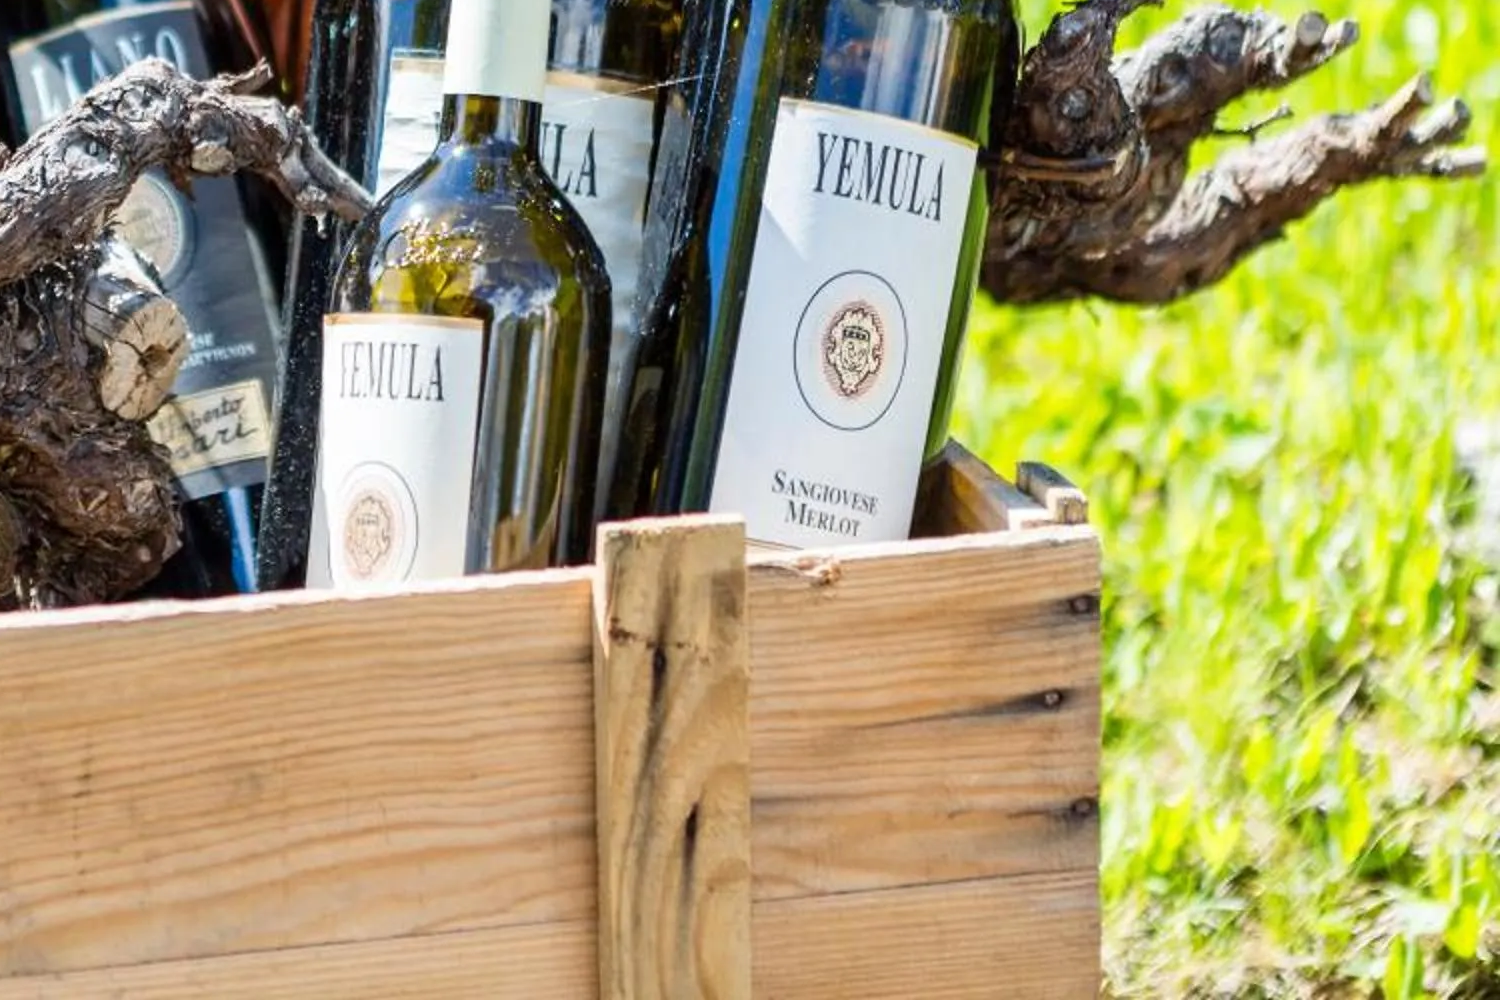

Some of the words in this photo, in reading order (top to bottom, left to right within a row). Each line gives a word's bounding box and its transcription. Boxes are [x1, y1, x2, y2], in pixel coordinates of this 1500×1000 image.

[813, 131, 944, 222] YEMULA
[771, 469, 879, 516] SANGIOVESE
[785, 500, 861, 537] MERLOT
